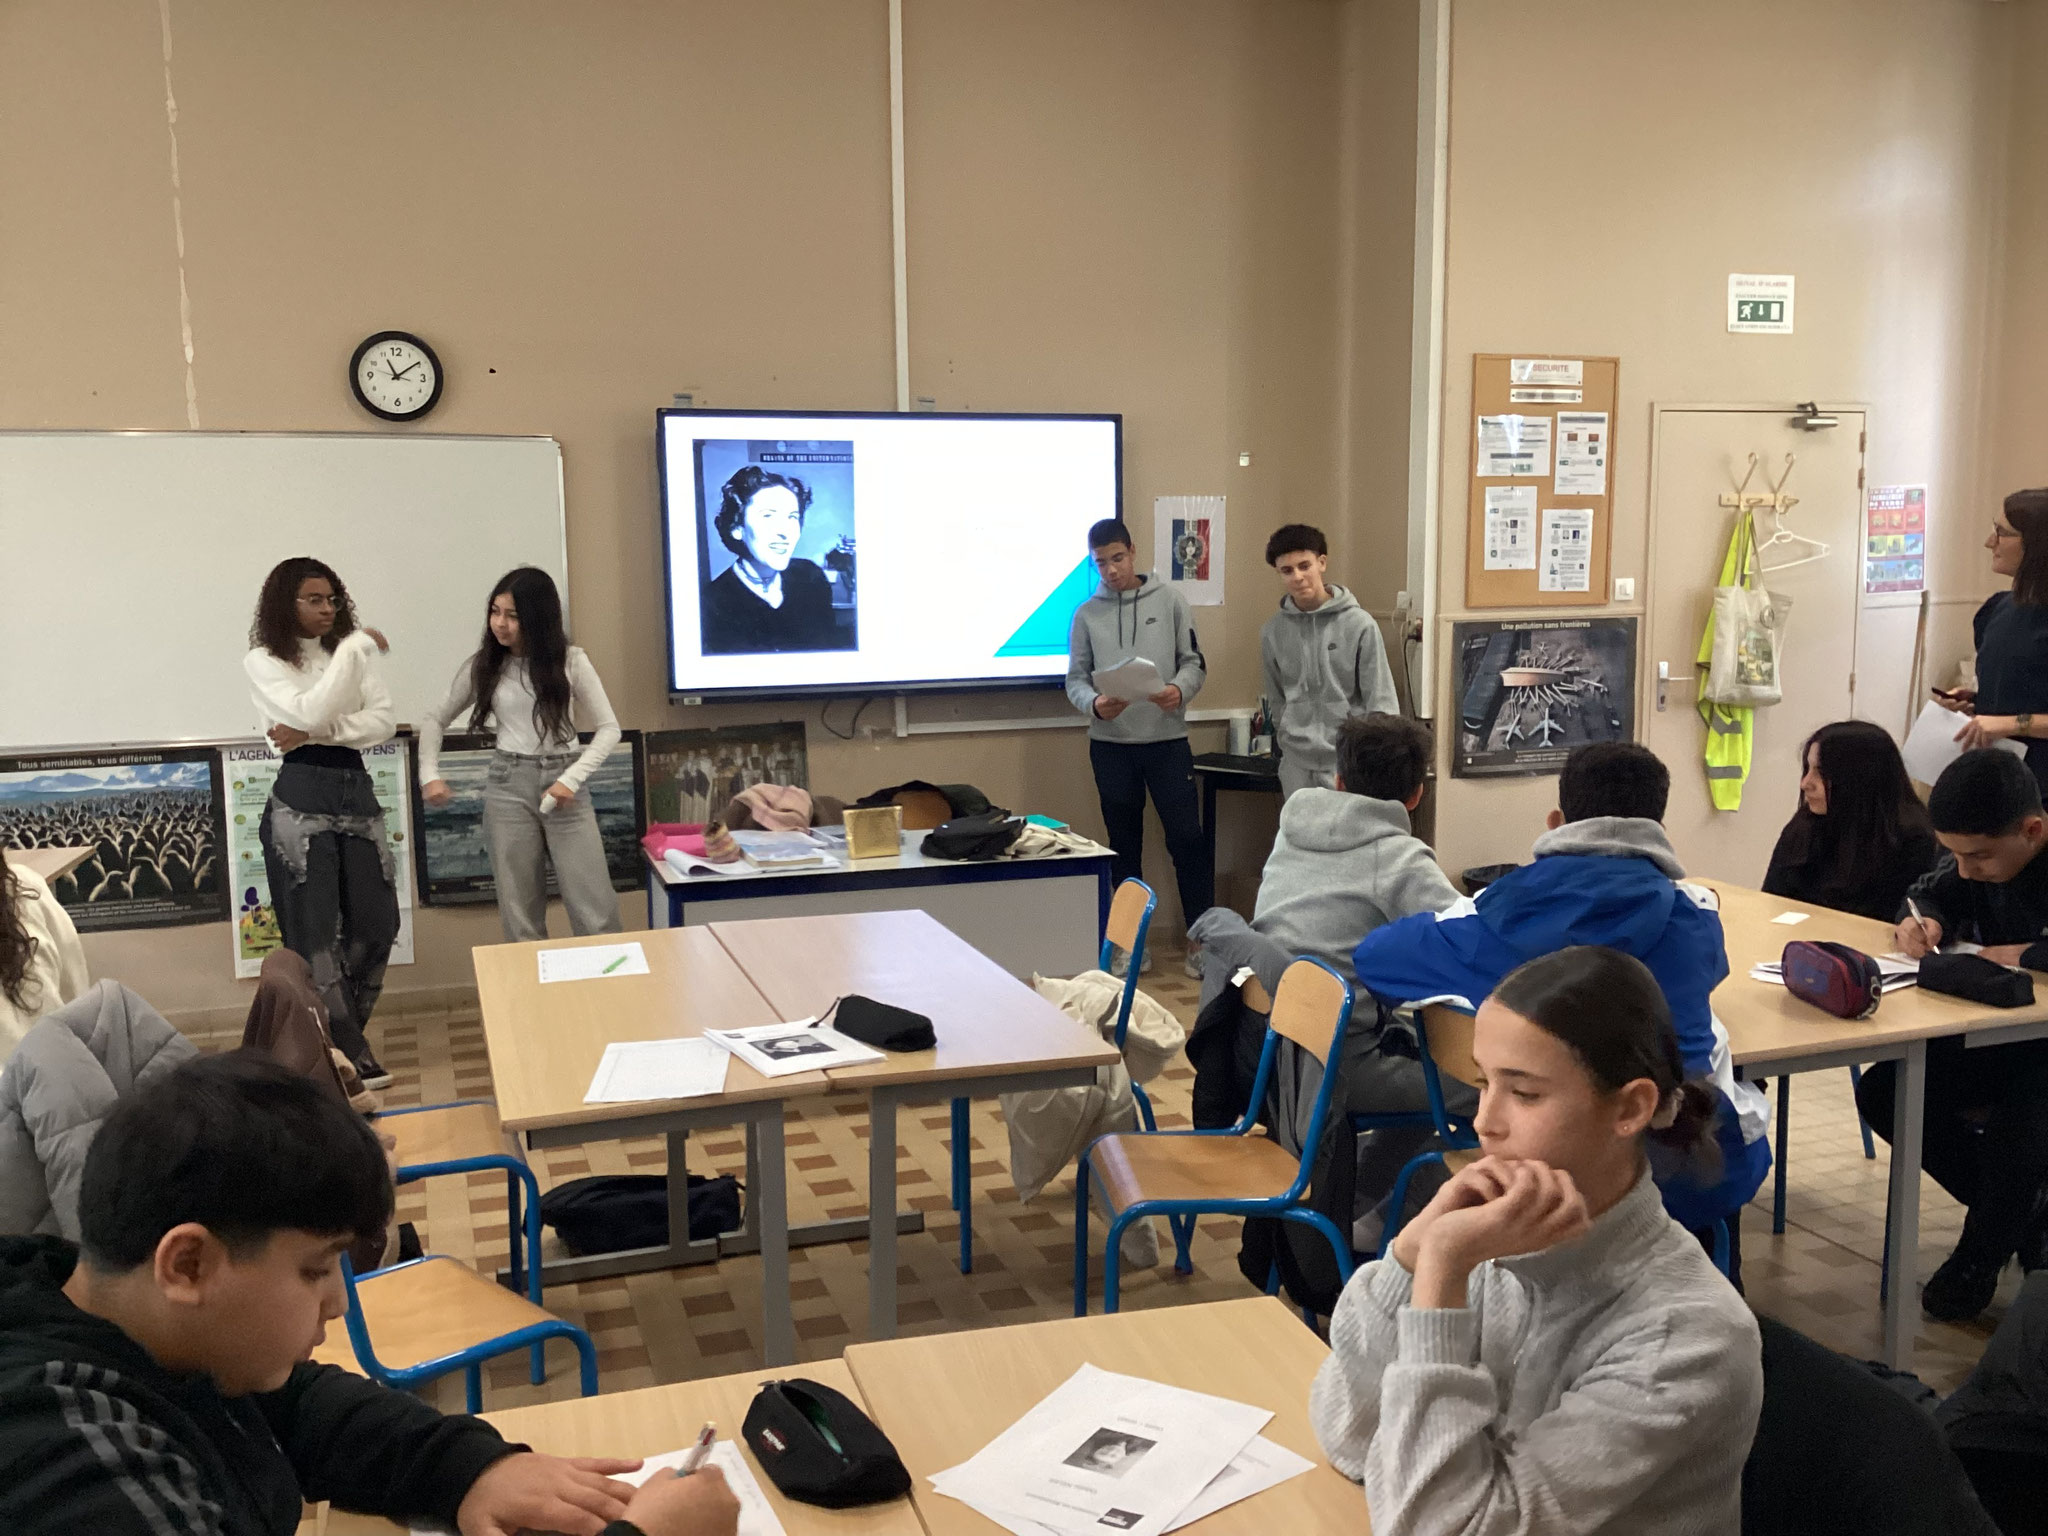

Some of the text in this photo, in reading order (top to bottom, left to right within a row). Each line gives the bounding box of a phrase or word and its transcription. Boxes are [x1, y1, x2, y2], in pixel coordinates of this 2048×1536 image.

[390, 347, 402, 357] 12
[367, 371, 374, 380] 9
[420, 374, 426, 382] 3
[394, 398, 401, 407] 6
[1515, 622, 1543, 631] pollution
[229, 749, 279, 761] L'AGEND
[17, 761, 38, 769] Tous
[40, 757, 95, 768] semblables,
[97, 757, 117, 765] tous
